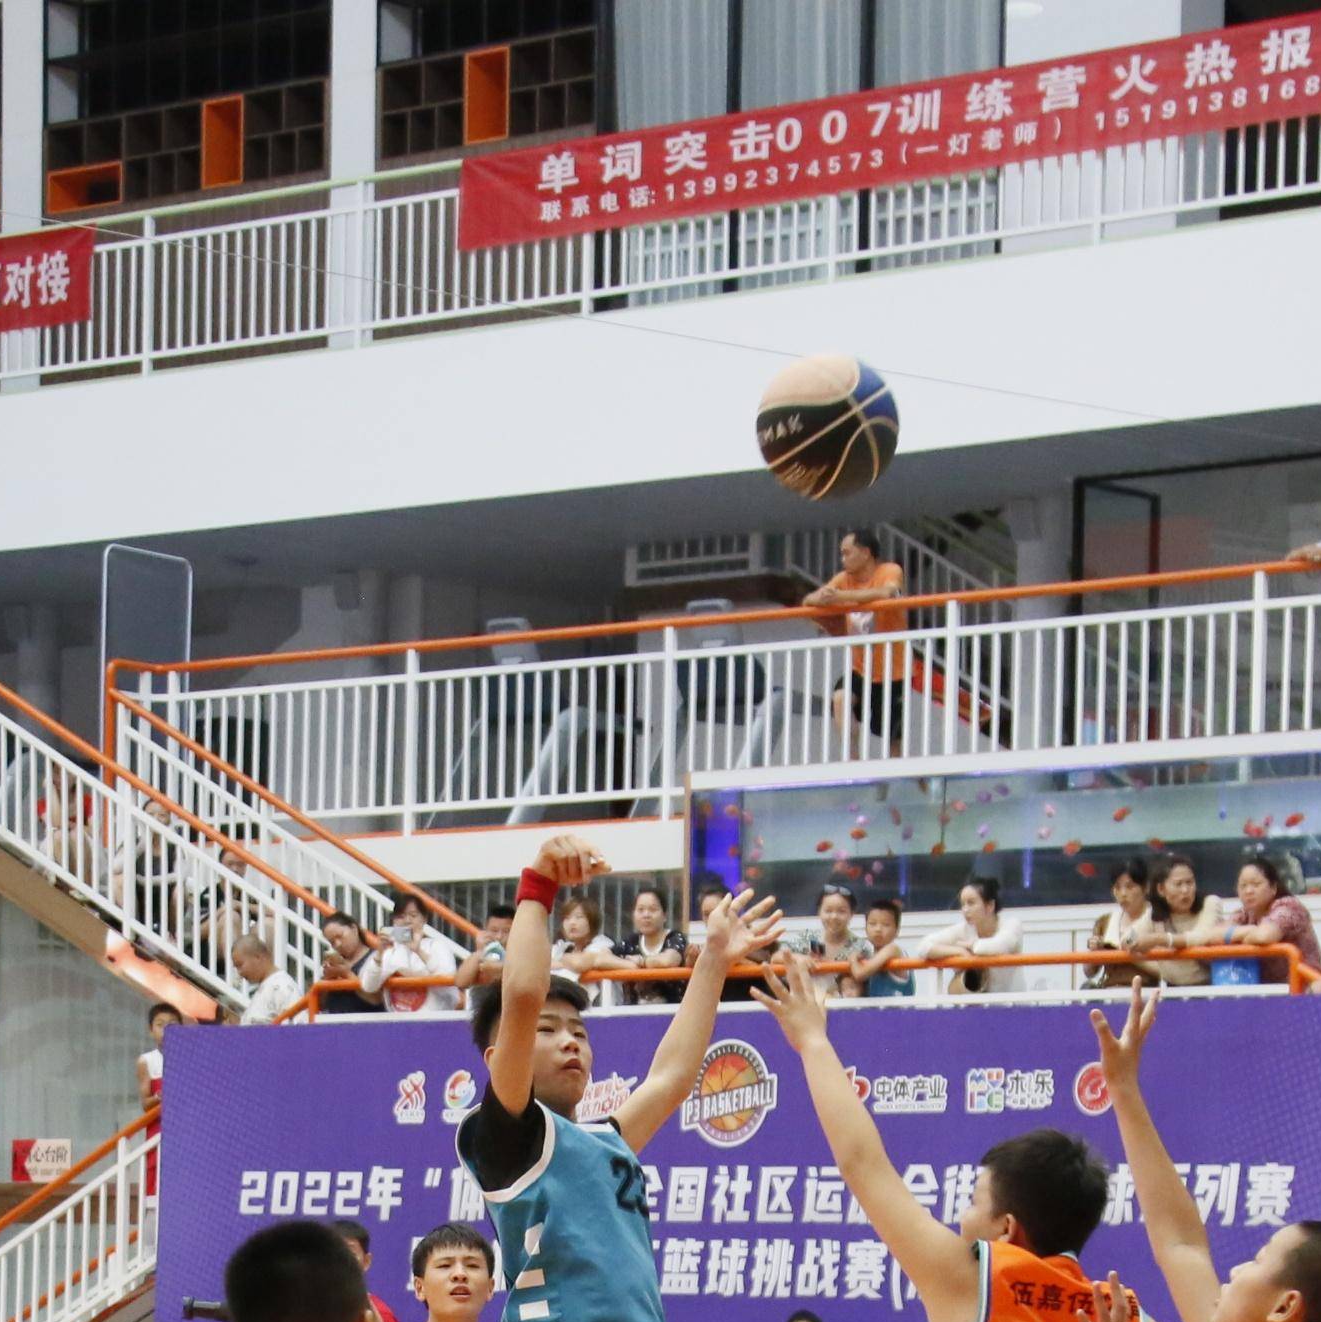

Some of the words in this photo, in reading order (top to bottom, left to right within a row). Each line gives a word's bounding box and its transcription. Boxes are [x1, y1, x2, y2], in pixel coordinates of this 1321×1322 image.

[686, 1099, 700, 1123] P3
[703, 1081, 773, 1119] BASKETBALL
[876, 1077, 946, 1101] 中体产业
[239, 1166, 404, 1222] 2022年
